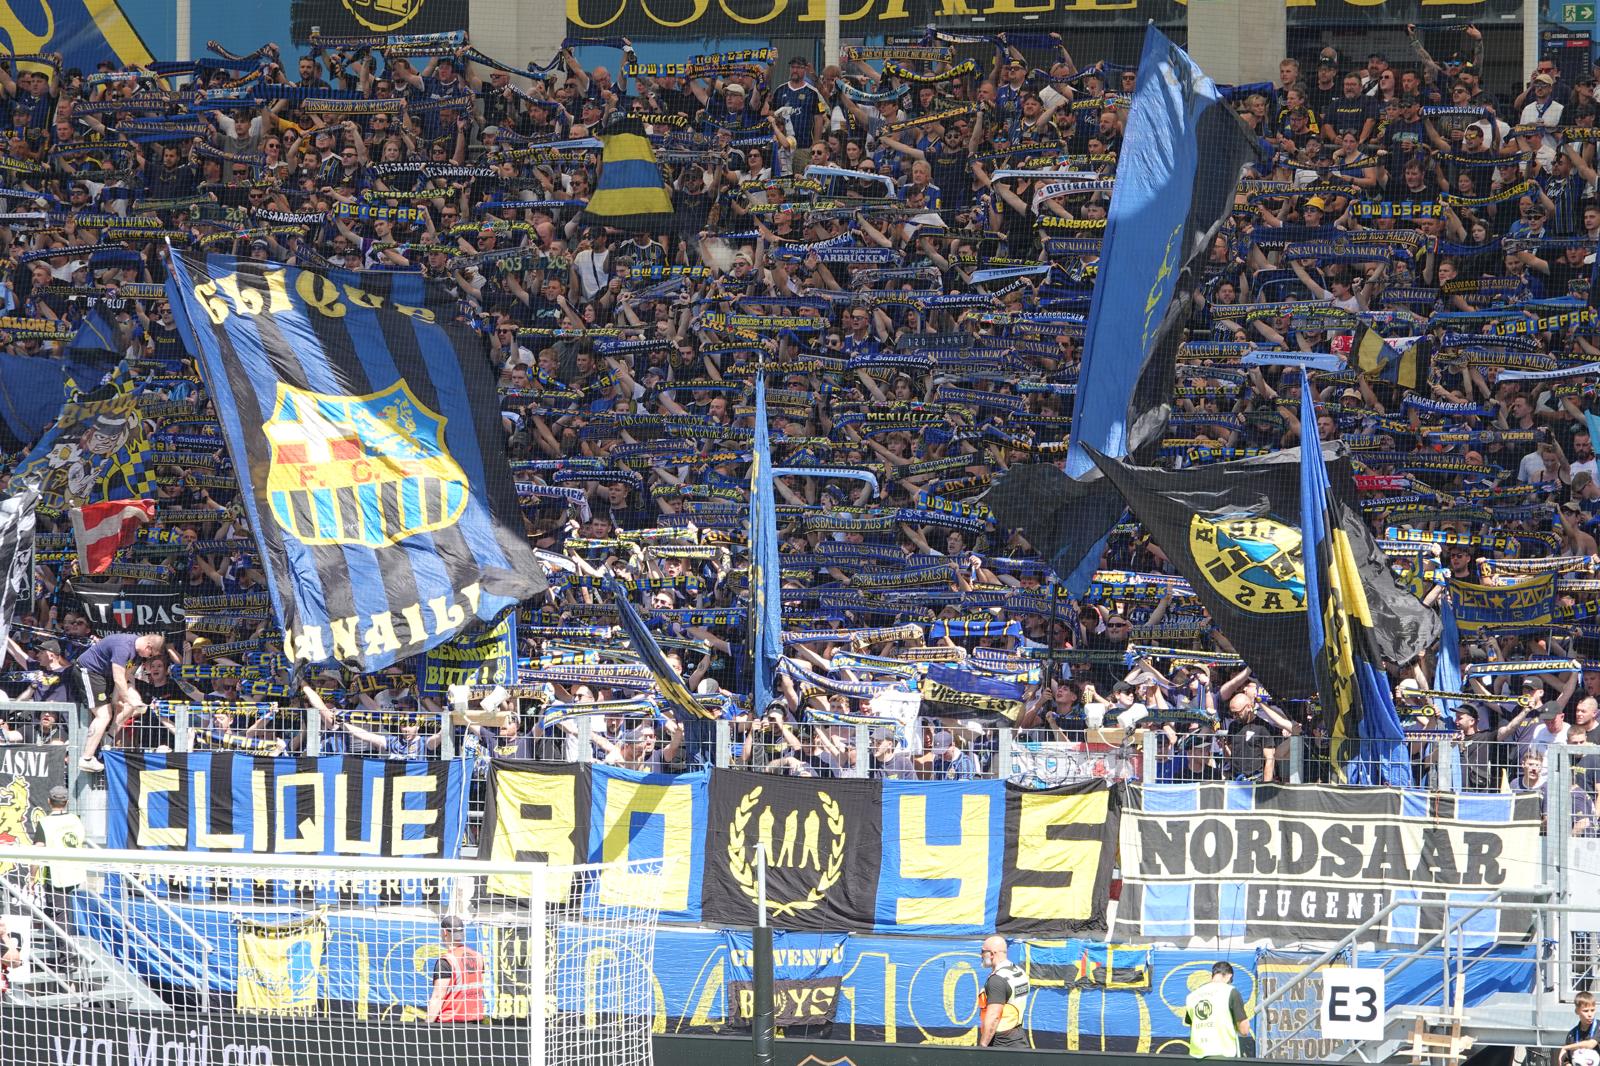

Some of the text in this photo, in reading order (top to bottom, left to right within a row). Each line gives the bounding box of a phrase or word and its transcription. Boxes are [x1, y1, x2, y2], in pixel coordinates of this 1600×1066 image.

[1437, 106, 1485, 116] SAARBRÜCKEN
[1046, 181, 1115, 195] OSTFRANKRE
[333, 203, 426, 221] UDWIGSPARK
[752, 203, 777, 212] ARRE
[1352, 203, 1442, 217] UDWIGSPAR
[271, 211, 326, 223] SAARBRÜCKEN
[815, 253, 888, 263] AARBRÜCKEN
[120, 284, 163, 297] SSBALLCLUB
[908, 338, 927, 347] 120
[1466, 352, 1505, 364] SBALLCLUB
[1508, 354, 1522, 364] AUS
[1501, 431, 1534, 441] VEREIN
[1424, 463, 1491, 474] SAARBRÜCKEN
[926, 509, 984, 530] Saarbrücke
[1396, 531, 1517, 553] UDWIGSPARK
[183, 593, 232, 609] SSBALLCLUB
[1486, 664, 1499, 673] FC
[1501, 660, 1573, 672] SAARBRÜCKEN
[986, 697, 1018, 713] EST
[1, 750, 49, 778] ASNL
[137, 768, 440, 858] CLIQUE
[1138, 819, 1506, 885] NORDSAAR
[1329, 986, 1379, 1022] E3
[1266, 1009, 1308, 1033] PAS
[54, 1025, 273, 1066] via Mail an
